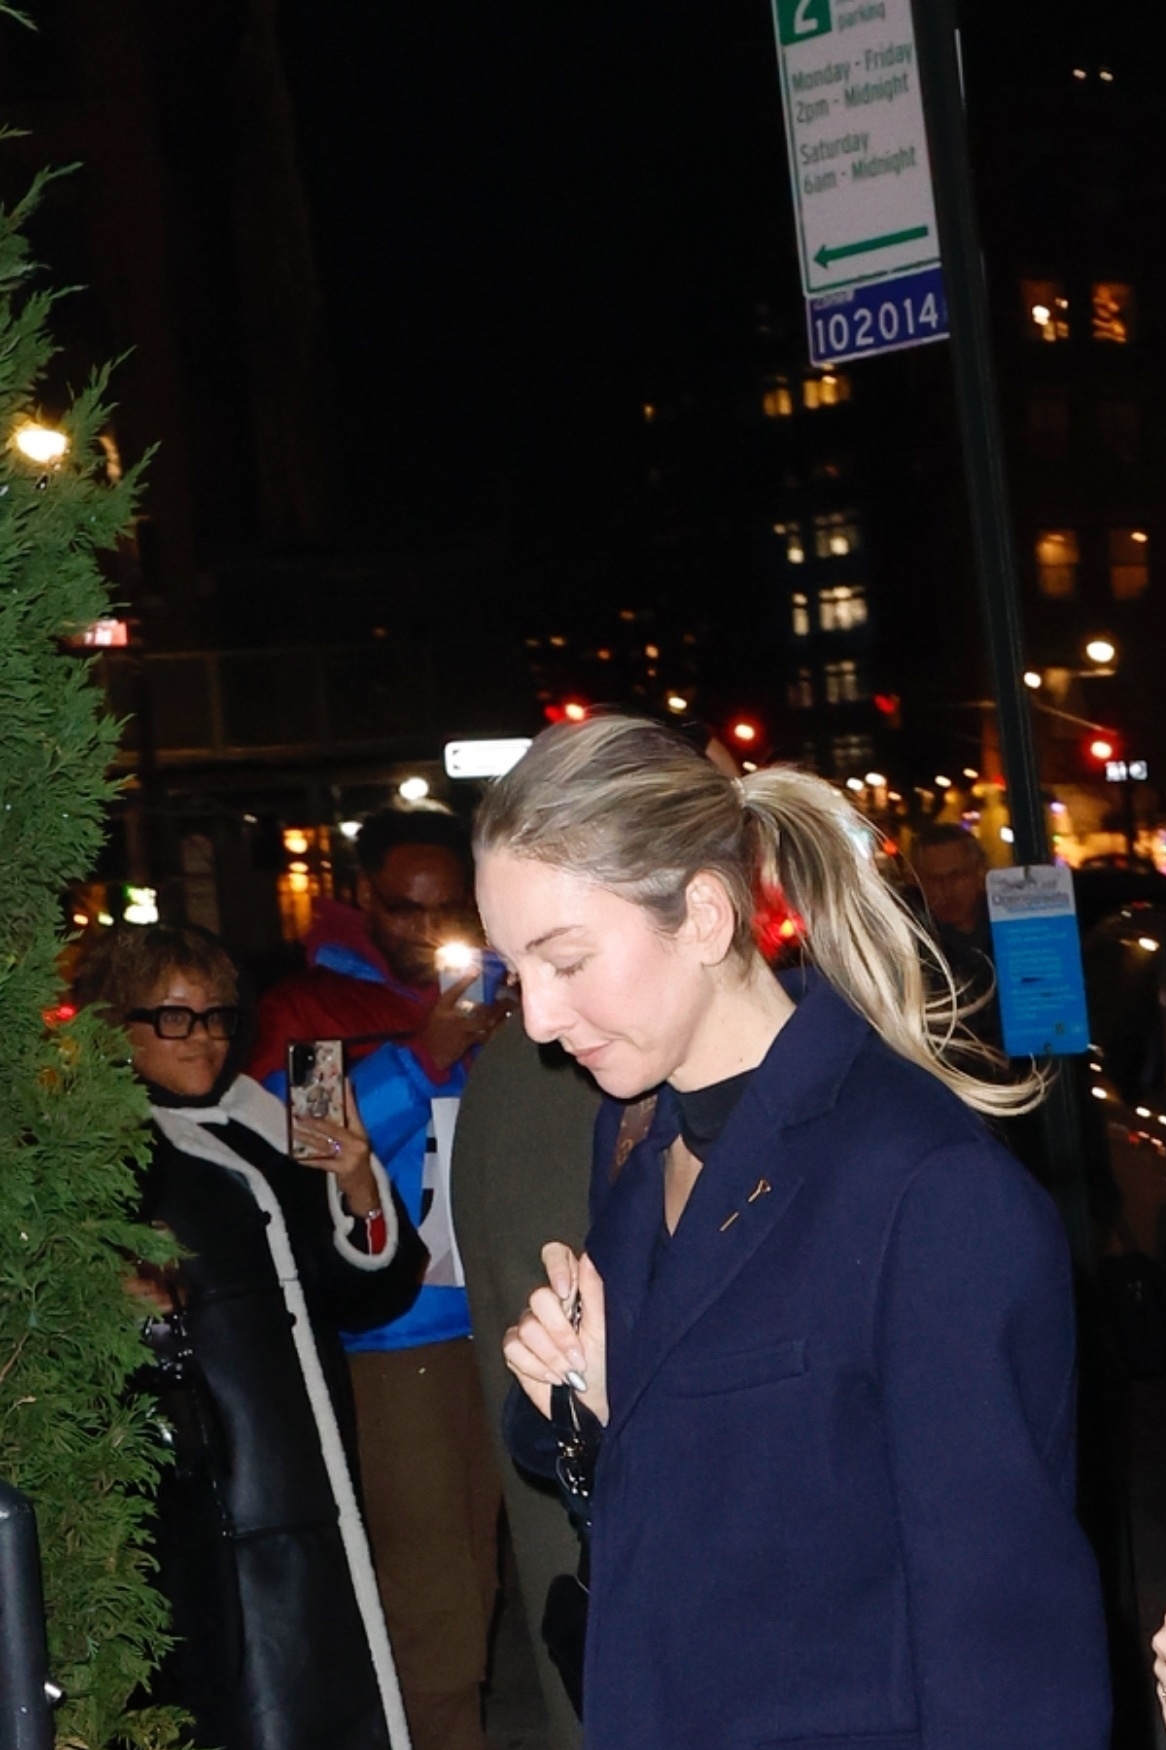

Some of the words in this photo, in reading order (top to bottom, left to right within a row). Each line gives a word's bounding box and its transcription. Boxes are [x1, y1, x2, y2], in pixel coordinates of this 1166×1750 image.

[792, 61, 850, 91] Monday
[865, 42, 913, 71] Friday
[796, 99, 829, 124] 2pm
[845, 73, 909, 107] Midnight
[800, 132, 868, 166] Saturday
[804, 170, 837, 195] 6am
[851, 146, 916, 180] Midnight
[815, 293, 938, 353] 102014
